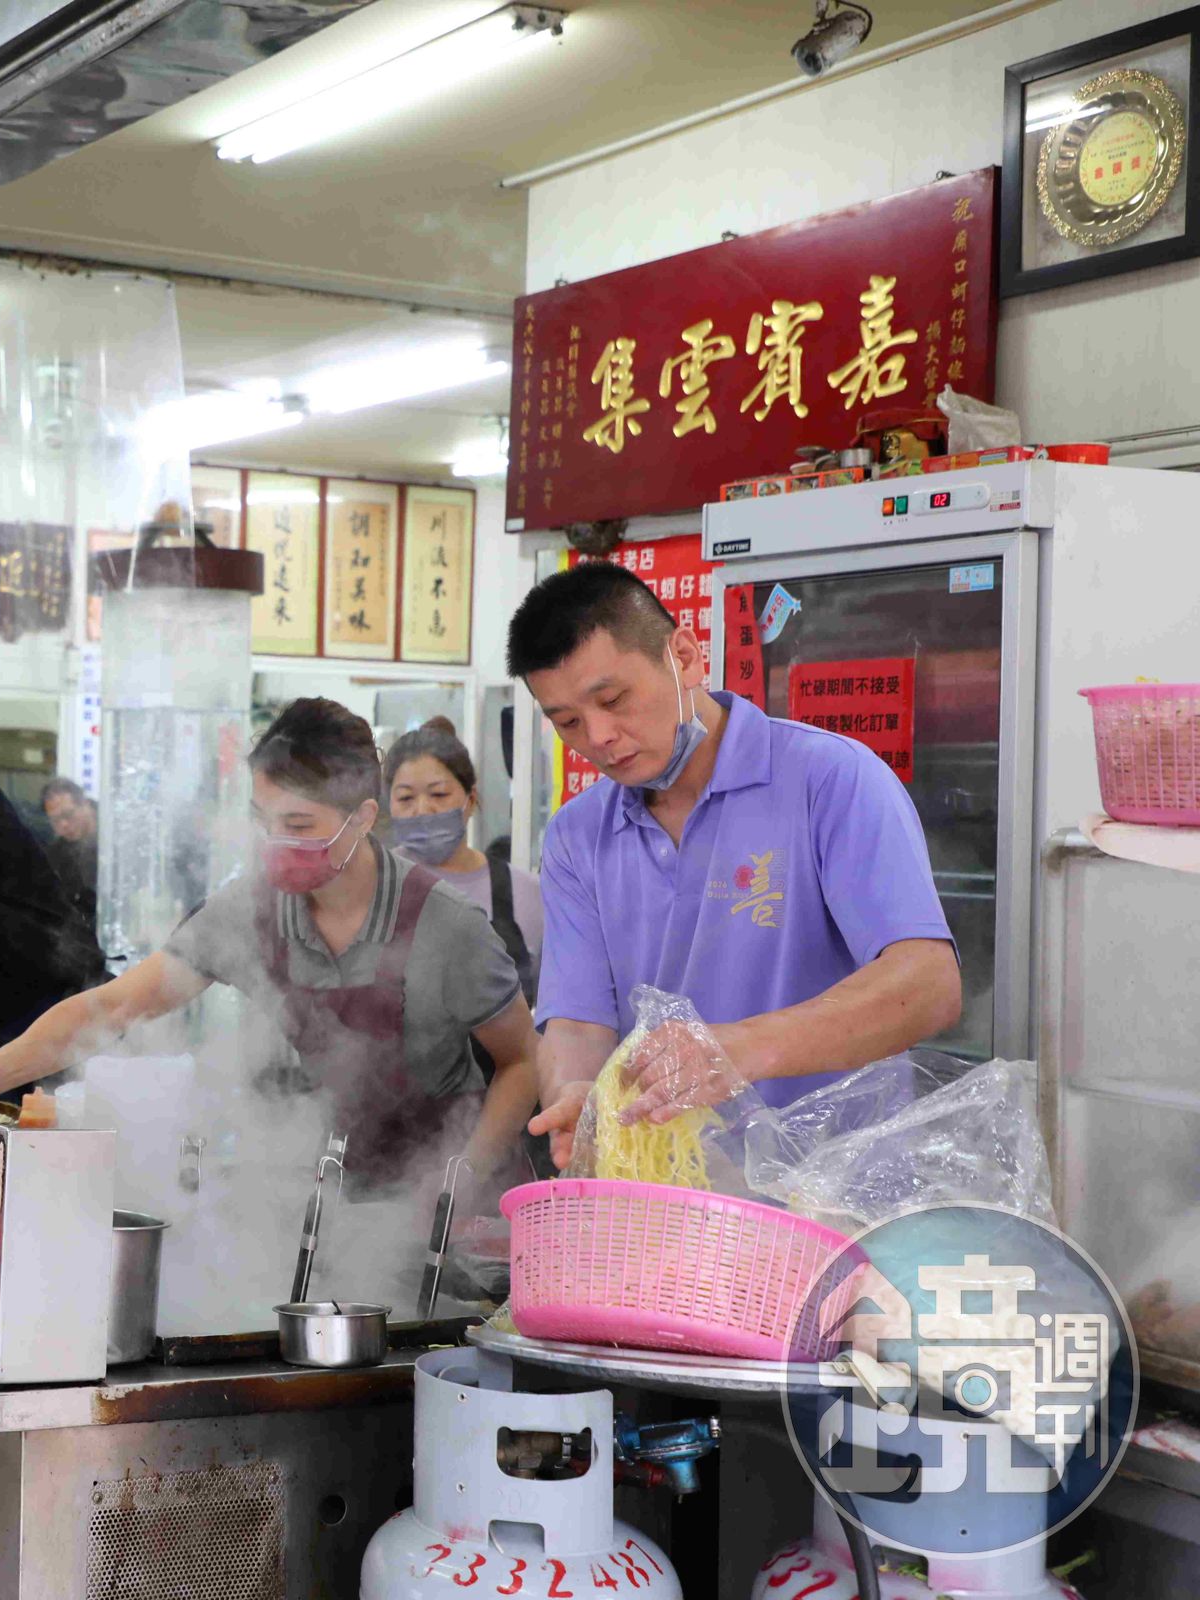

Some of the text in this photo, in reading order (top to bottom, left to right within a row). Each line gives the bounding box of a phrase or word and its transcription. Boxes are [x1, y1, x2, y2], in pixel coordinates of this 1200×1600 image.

[583, 275, 918, 455] 嘉賓雲集
[800, 676, 900, 697] 忙碌期間不接受
